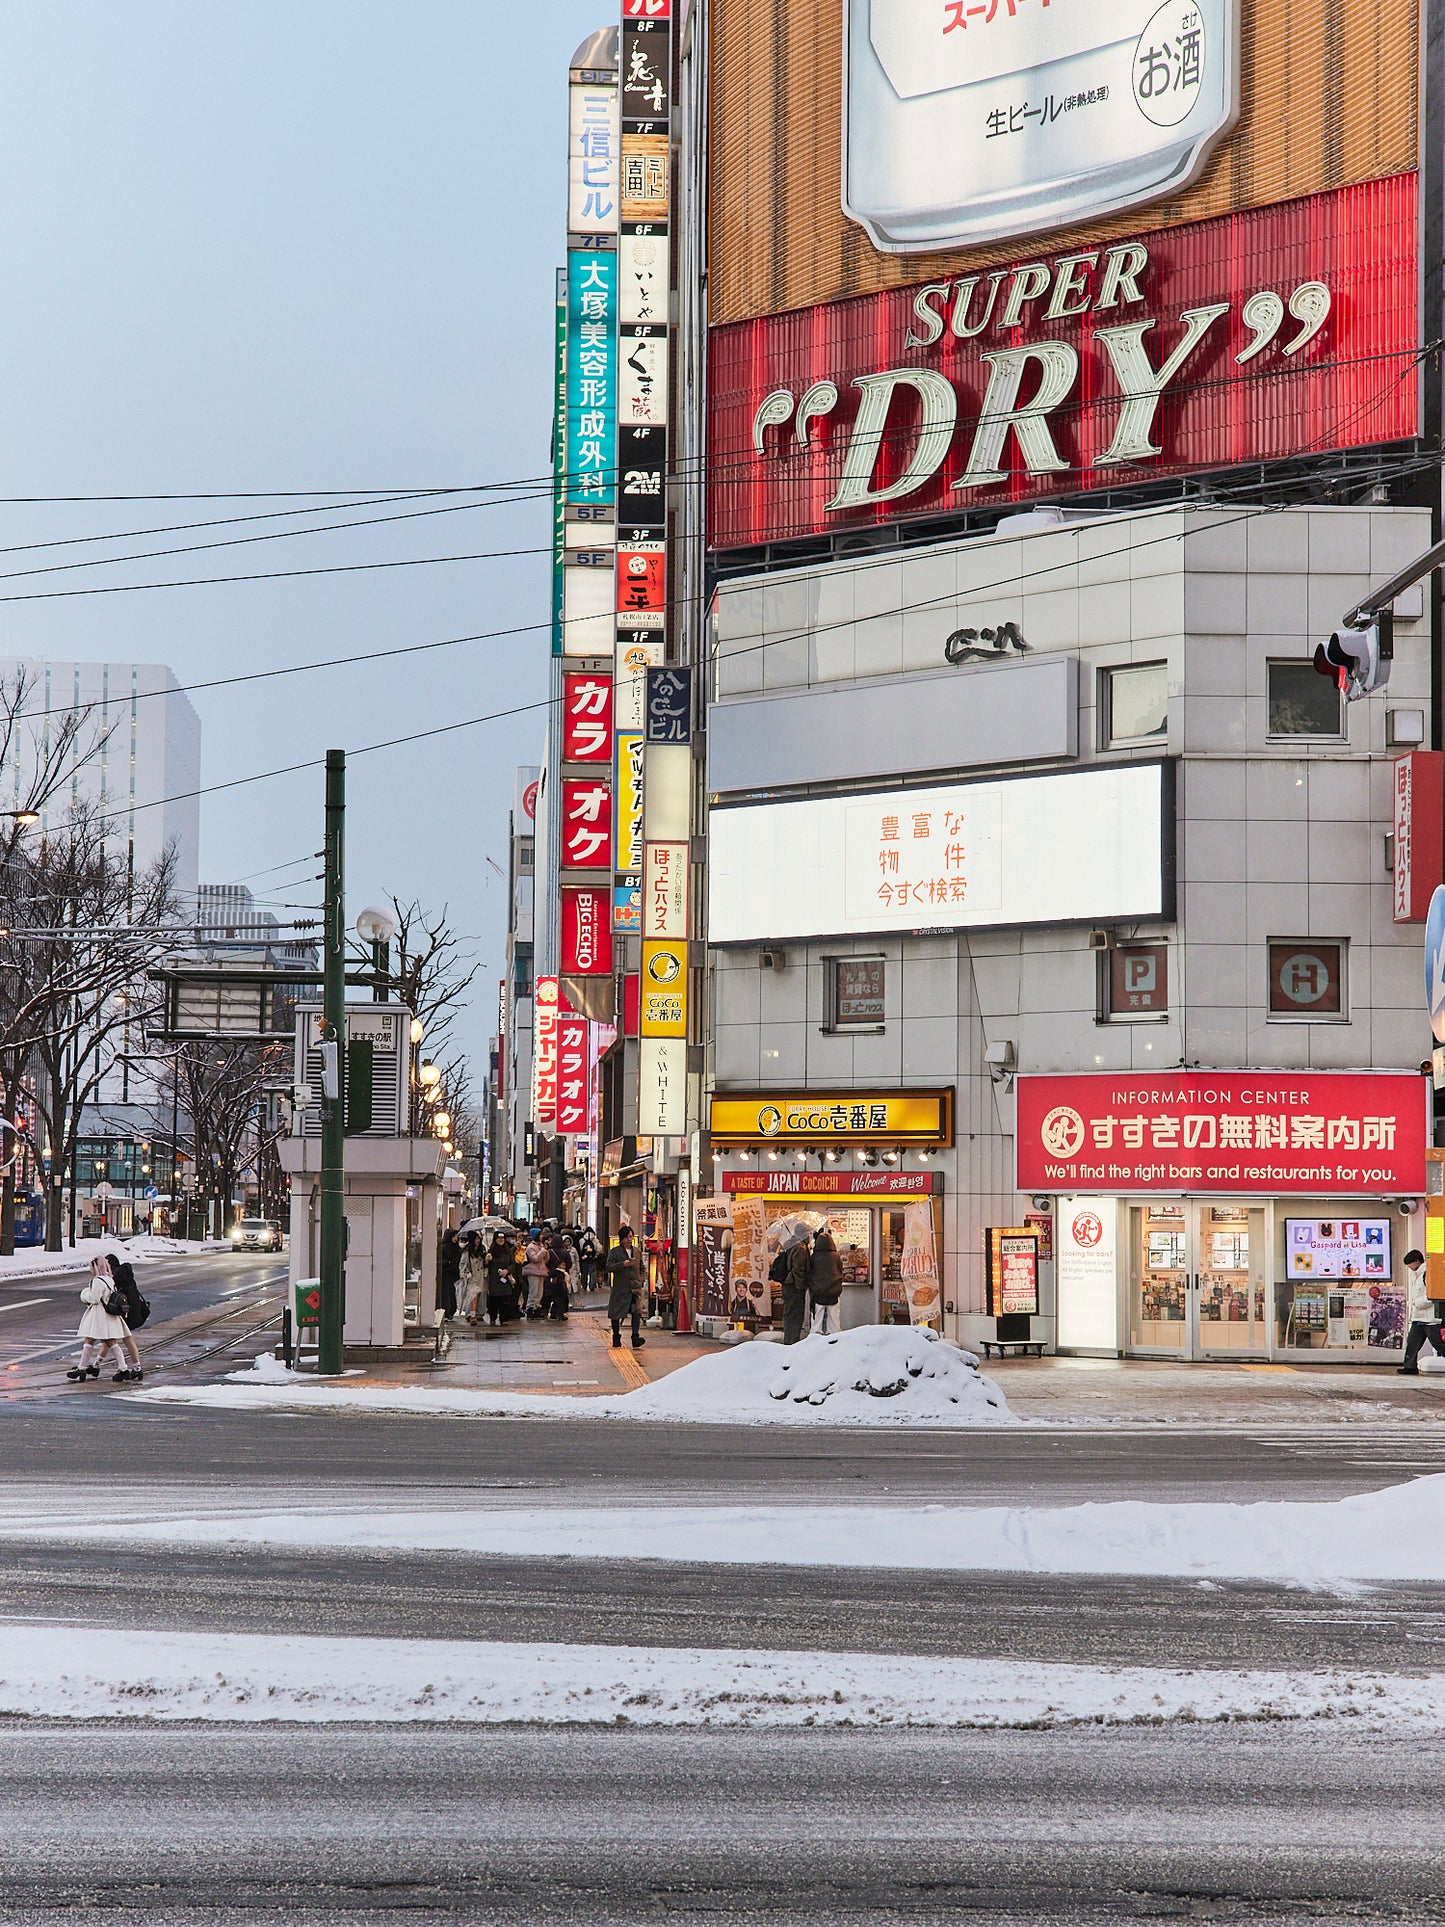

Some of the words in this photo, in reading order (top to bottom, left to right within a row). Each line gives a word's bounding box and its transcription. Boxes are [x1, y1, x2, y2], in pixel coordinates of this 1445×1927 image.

[637, 21, 654, 31] 8F
[1181, 12, 1198, 28] さけ
[1138, 28, 1201, 99] お酒
[636, 123, 653, 133] 7F
[579, 96, 613, 220] 三信ビル
[635, 225, 652, 235] 6F
[580, 236, 609, 247] 7F
[904, 241, 1149, 350] SUPER
[634, 327, 651, 337] 5F
[577, 261, 609, 498] 大塚美容形成外科
[632, 428, 651, 438] 4F
[577, 508, 606, 519] 5F
[632, 530, 650, 540] 3F
[576, 553, 606, 564] 5F
[632, 632, 649, 642] 1F
[580, 661, 602, 669] 1F
[654, 849, 670, 930] ほっとハウス
[877, 877, 967, 907] 今すぐ検索
[578, 893, 592, 923] BIG
[577, 926, 592, 969] ECHO
[1131, 960, 1150, 987] P
[649, 998, 679, 1008] CoCo
[842, 1002, 883, 1013] ほっとハウス
[537, 1013, 558, 1123] ジャンカラ
[559, 1028, 584, 1126] カラオケ
[657, 1062, 668, 1127] WHITE
[1112, 1090, 1231, 1104] INFORMATION
[1241, 1091, 1310, 1104] CENTER
[1090, 1114, 1397, 1150] すすきの無料案内所
[1044, 1164, 1076, 1178] We'll
[1080, 1164, 1105, 1178] find
[1108, 1164, 1131, 1178] the
[1135, 1164, 1165, 1182] right
[1169, 1164, 1202, 1178] bars
[1207, 1164, 1240, 1179] and
[1243, 1165, 1332, 1180] restaurants
[1336, 1165, 1358, 1180] for
[1362, 1167, 1397, 1183] you.
[730, 1176, 736, 1189] A
[737, 1175, 755, 1189] TASTE
[756, 1174, 765, 1188] OF
[767, 1173, 800, 1192] JAPAN
[850, 1174, 887, 1193] Welcome
[1311, 1241, 1341, 1250] Gaspard
